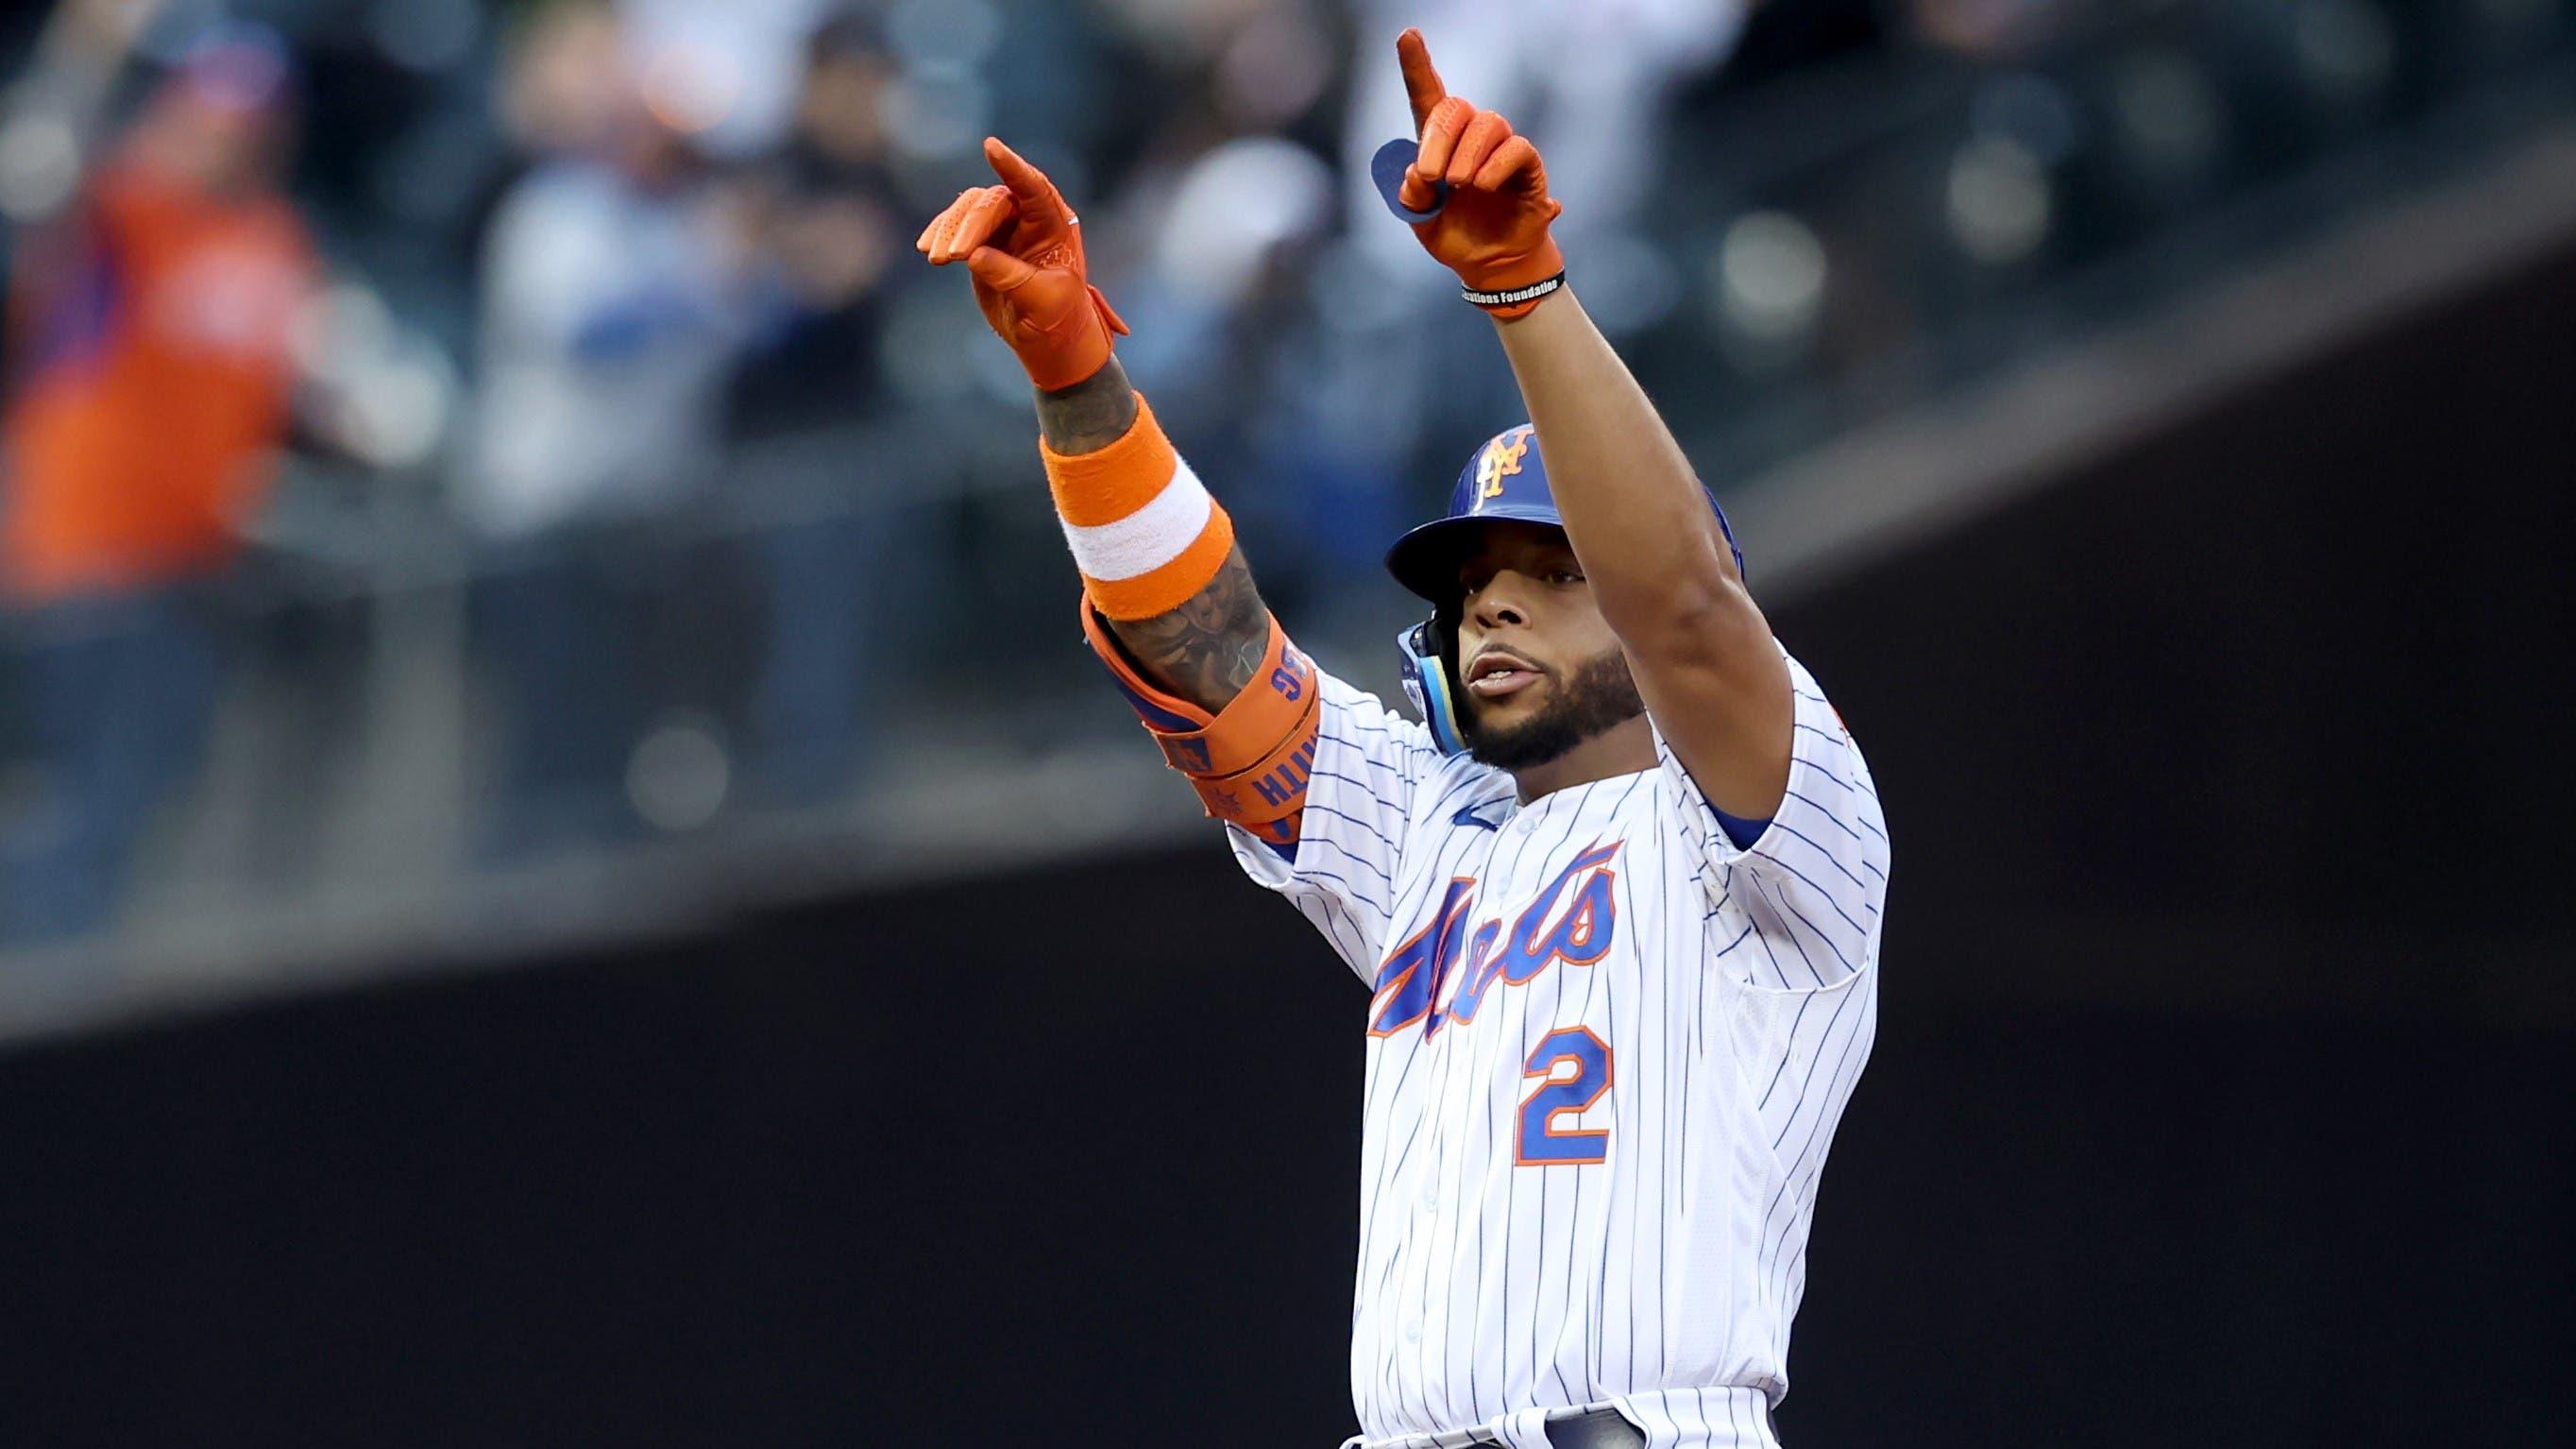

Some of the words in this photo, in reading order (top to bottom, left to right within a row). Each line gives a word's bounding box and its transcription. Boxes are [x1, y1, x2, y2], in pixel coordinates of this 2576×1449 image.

[1500, 279, 1558, 303] Foundation
[1366, 833, 1625, 1045] Mets
[1514, 1024, 1615, 1167] 2
